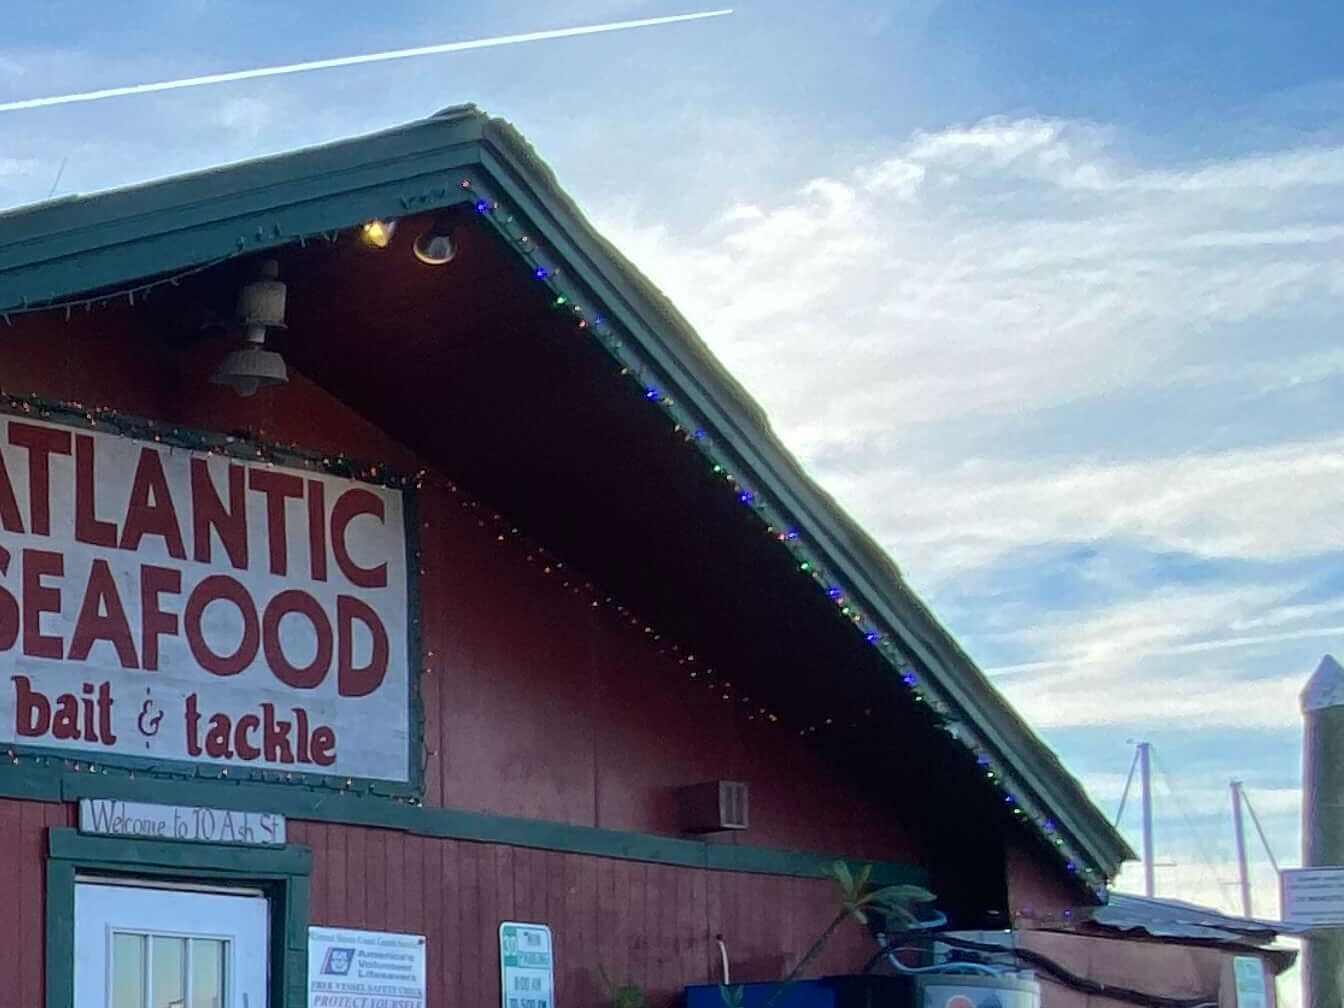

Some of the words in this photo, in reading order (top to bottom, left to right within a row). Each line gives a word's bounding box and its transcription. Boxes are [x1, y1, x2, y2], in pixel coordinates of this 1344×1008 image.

[12, 675, 117, 746] bait
[137, 697, 164, 738] &
[185, 693, 336, 767] tackle
[90, 800, 165, 834] Welcome
[174, 807, 188, 840] to
[219, 810, 255, 842] Ash
[259, 813, 280, 843] St
[313, 994, 369, 1008] PROTECT
